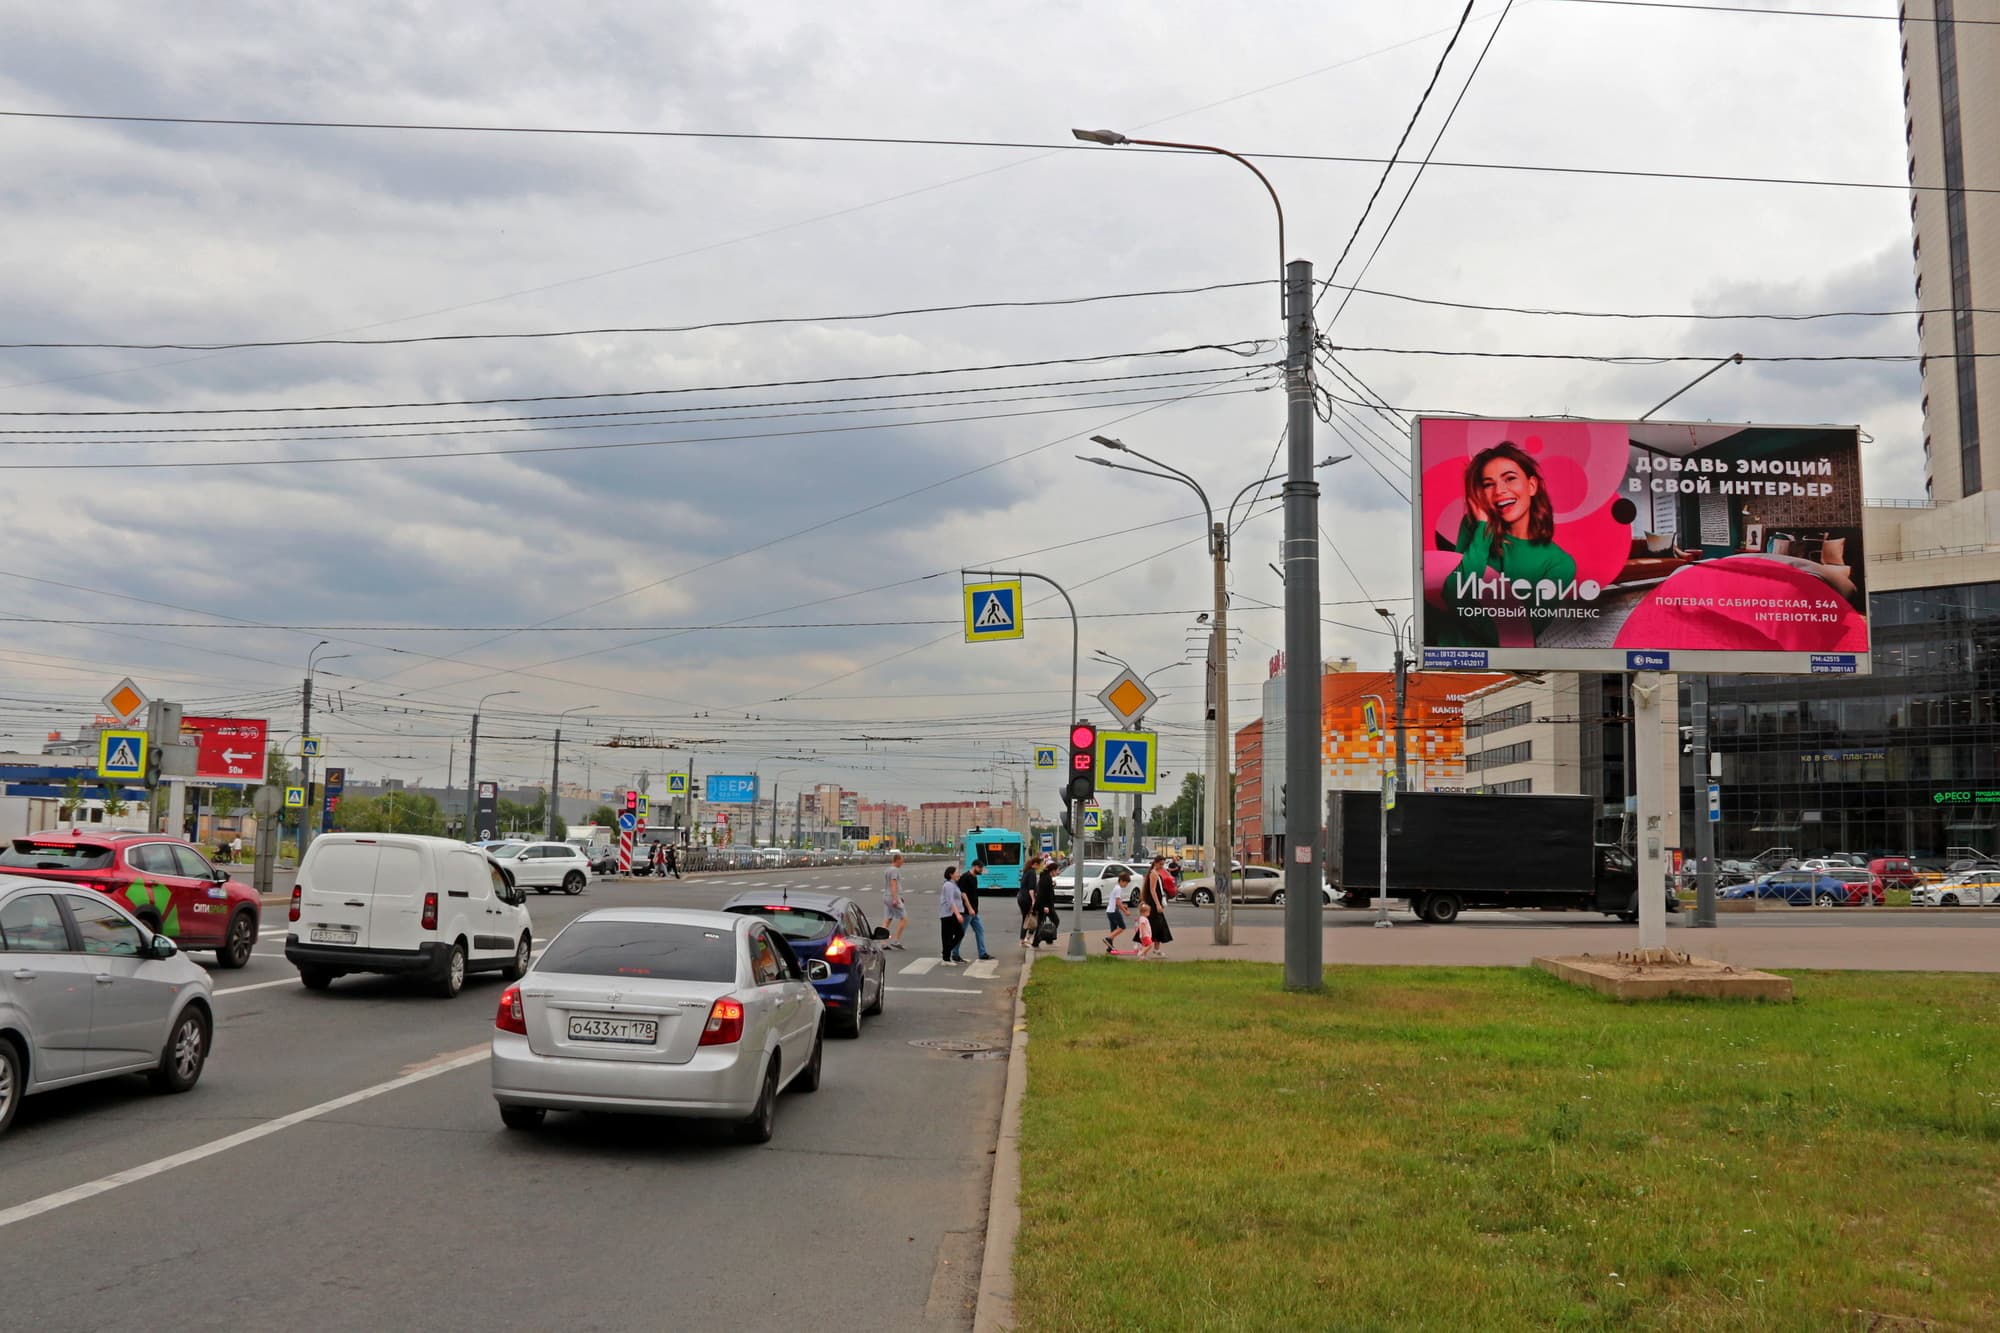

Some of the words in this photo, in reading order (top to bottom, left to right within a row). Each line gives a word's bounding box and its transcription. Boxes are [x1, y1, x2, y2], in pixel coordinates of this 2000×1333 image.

[1635, 457, 1729, 474] ДОБАВЬ
[1736, 458, 1832, 477] ЭМОЦИЙ
[1628, 478, 1642, 493] В
[1650, 476, 1711, 494] СВОЙ
[1719, 480, 1833, 497] ИНТЕРЬЕР
[1655, 597, 1714, 606] ПОЛЕВАЯ
[1718, 598, 1812, 609] САБИРОВСКАЯ,
[1457, 606, 1527, 618] ТОРГОВЫЙ
[1530, 608, 1600, 618] КОМПЛЕКС
[1755, 612, 1838, 622] INTERIOTK.RU
[1645, 656, 1664, 665] Russ
[1945, 791, 1971, 800] РЕСО
[631, 1023, 653, 1034] 178
